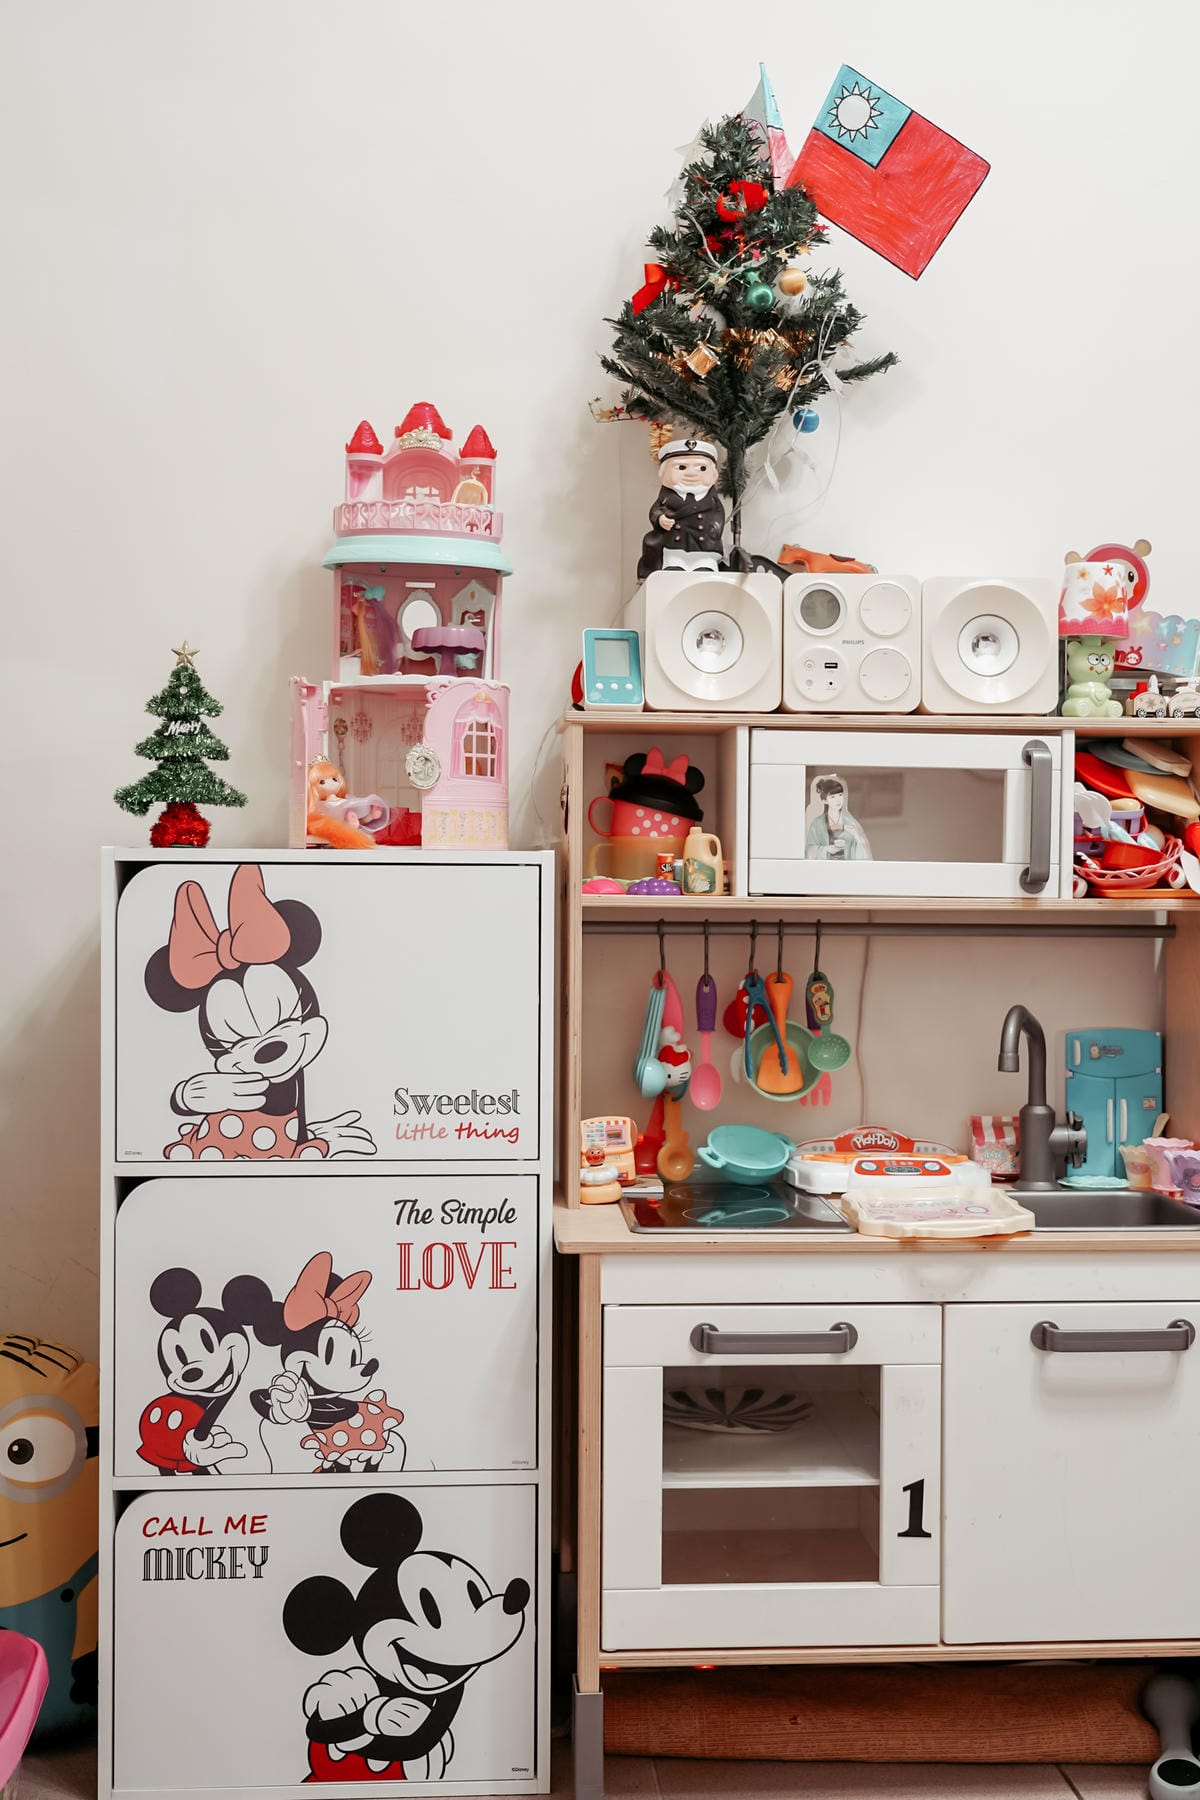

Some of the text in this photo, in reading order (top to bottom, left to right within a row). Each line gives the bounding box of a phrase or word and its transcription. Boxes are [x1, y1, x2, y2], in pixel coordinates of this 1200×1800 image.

[393, 1087, 521, 1116] Sweetest
[395, 1122, 520, 1144] little thing
[852, 1132, 897, 1149] Play-Doh
[394, 1197, 517, 1234] The Simple
[396, 1241, 517, 1290] LOVE
[896, 1478, 932, 1538] 1
[142, 1514, 268, 1538] CALL ME
[142, 1545, 270, 1581] MICKEY
